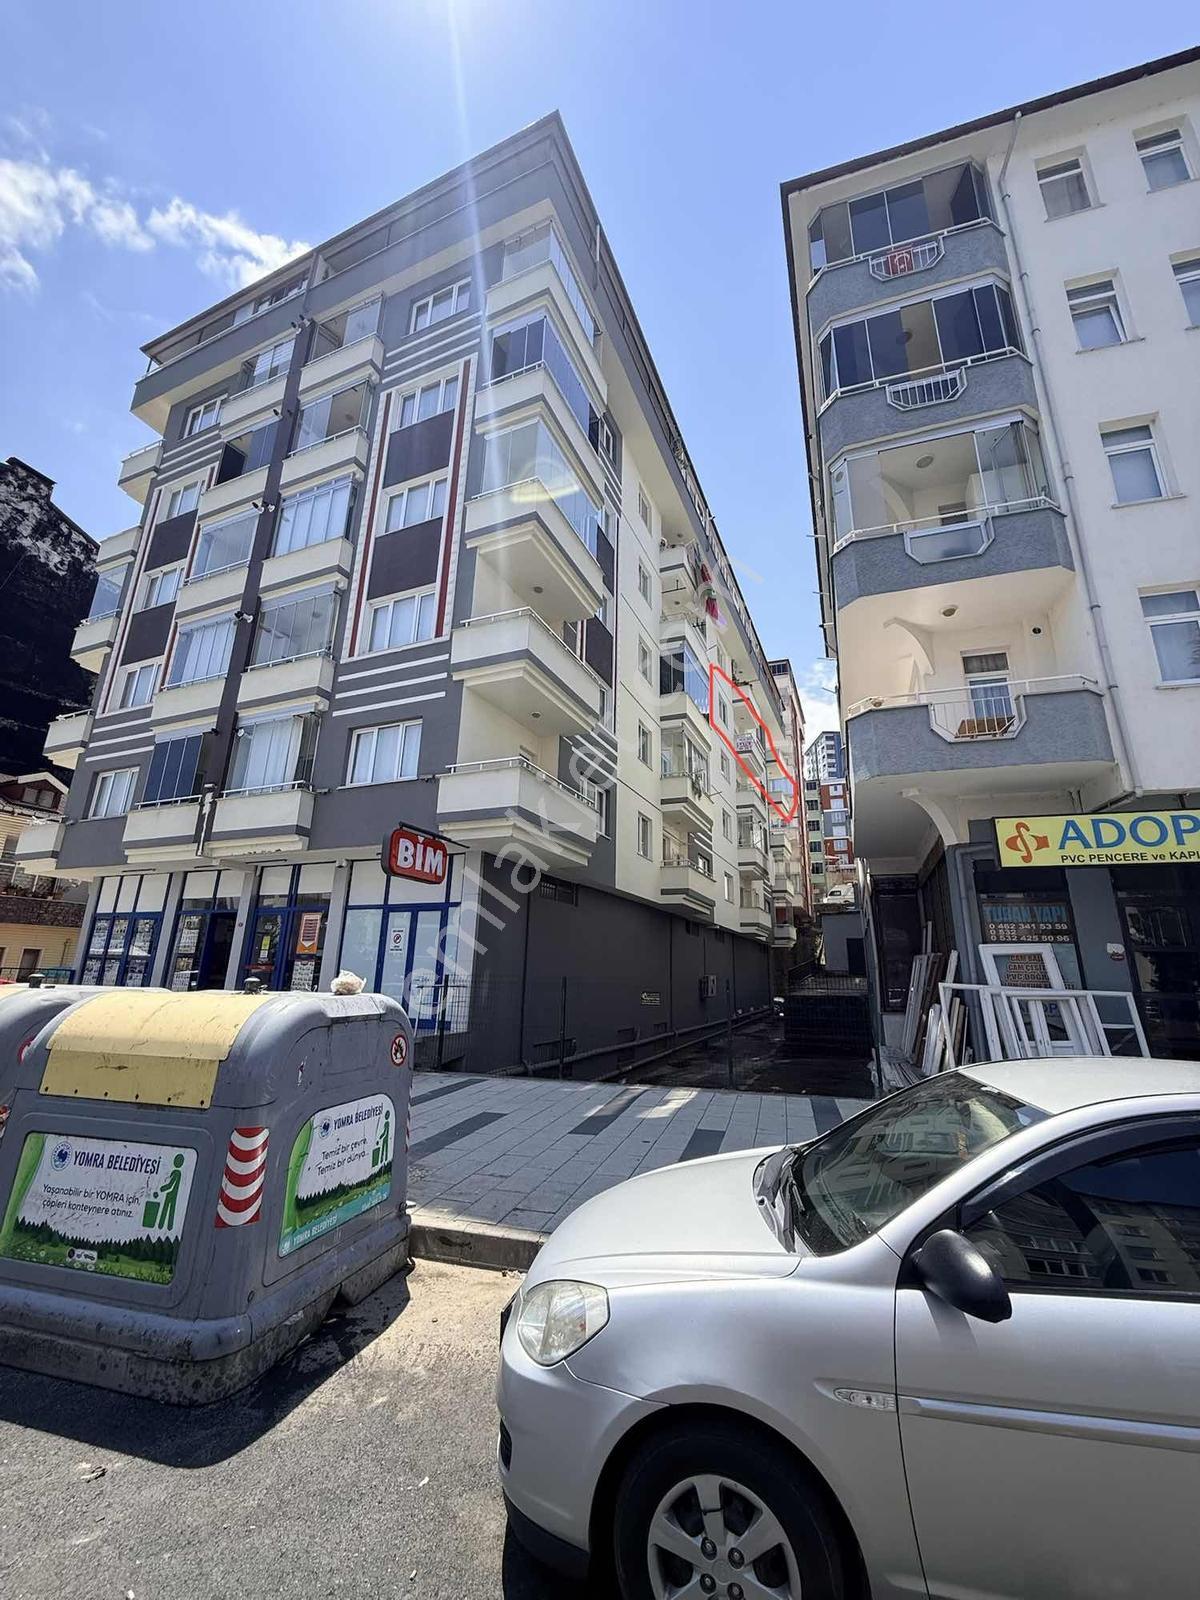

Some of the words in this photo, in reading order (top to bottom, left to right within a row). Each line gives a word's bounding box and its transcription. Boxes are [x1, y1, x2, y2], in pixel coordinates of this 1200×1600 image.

[397, 836, 443, 876] BİM
[1061, 854, 1085, 863] PVC
[1089, 852, 1148, 863] PENCERE
[1152, 853, 1166, 861] ve
[334, 1116, 353, 1130] YOMRA
[73, 1151, 104, 1168] YOMRA
[107, 1153, 162, 1175] BELEDİYESİ
[43, 1184, 83, 1197] Yaşanabilir
[83, 1188, 94, 1198] bir
[95, 1190, 124, 1202] YOMRA
[68, 1203, 110, 1216] konteynere
